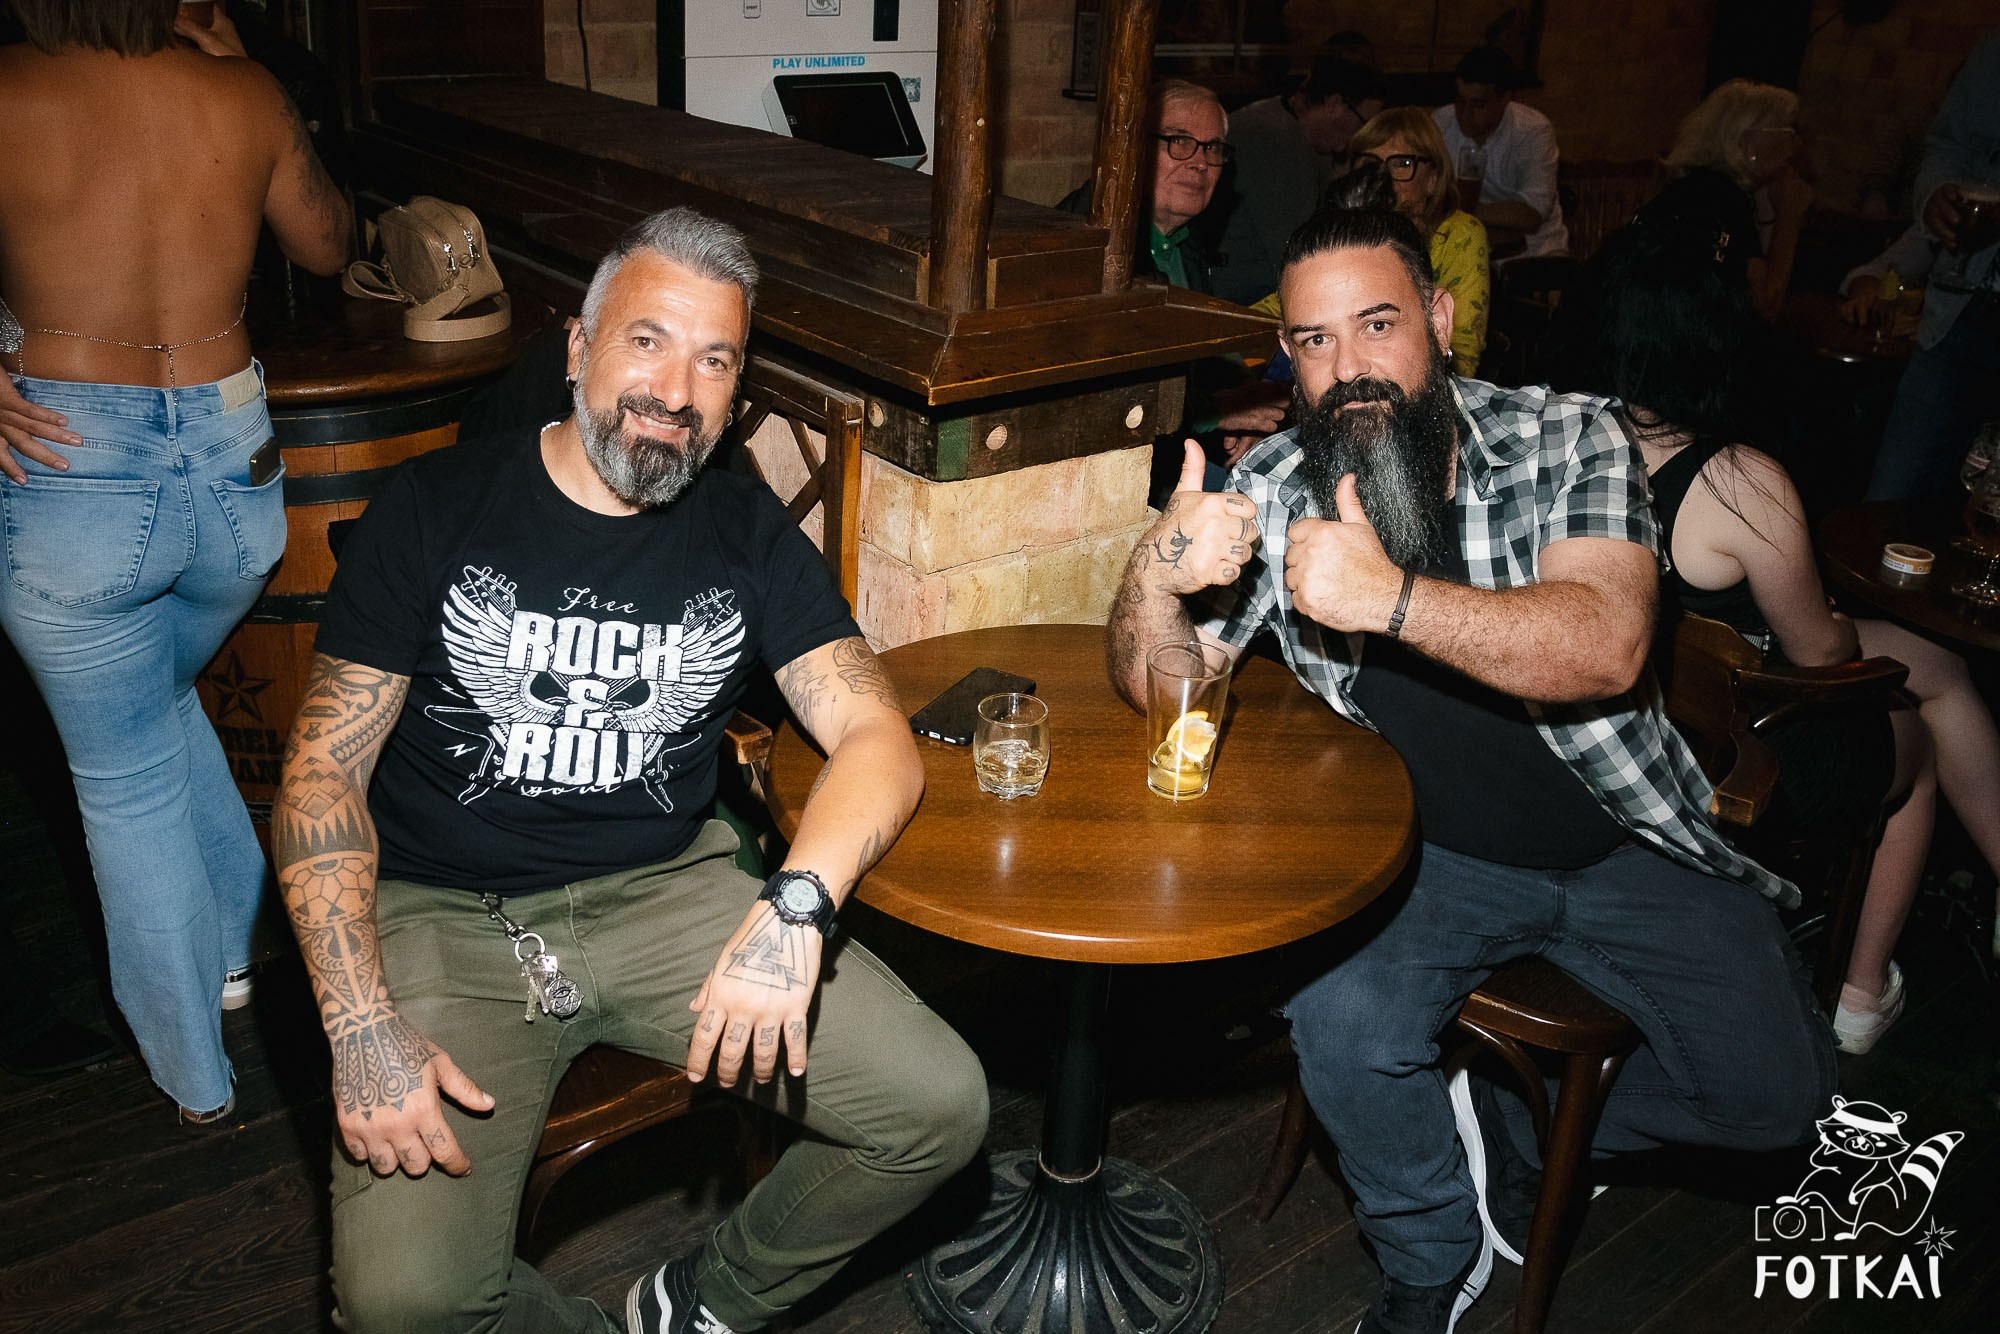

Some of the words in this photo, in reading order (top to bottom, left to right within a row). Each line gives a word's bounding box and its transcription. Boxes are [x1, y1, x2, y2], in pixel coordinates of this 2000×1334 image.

[772, 57, 801, 69] PLAY
[805, 55, 865, 68] UNLIMITED
[557, 587, 640, 614] Free
[505, 610, 685, 682] ROCK
[563, 679, 615, 730] &
